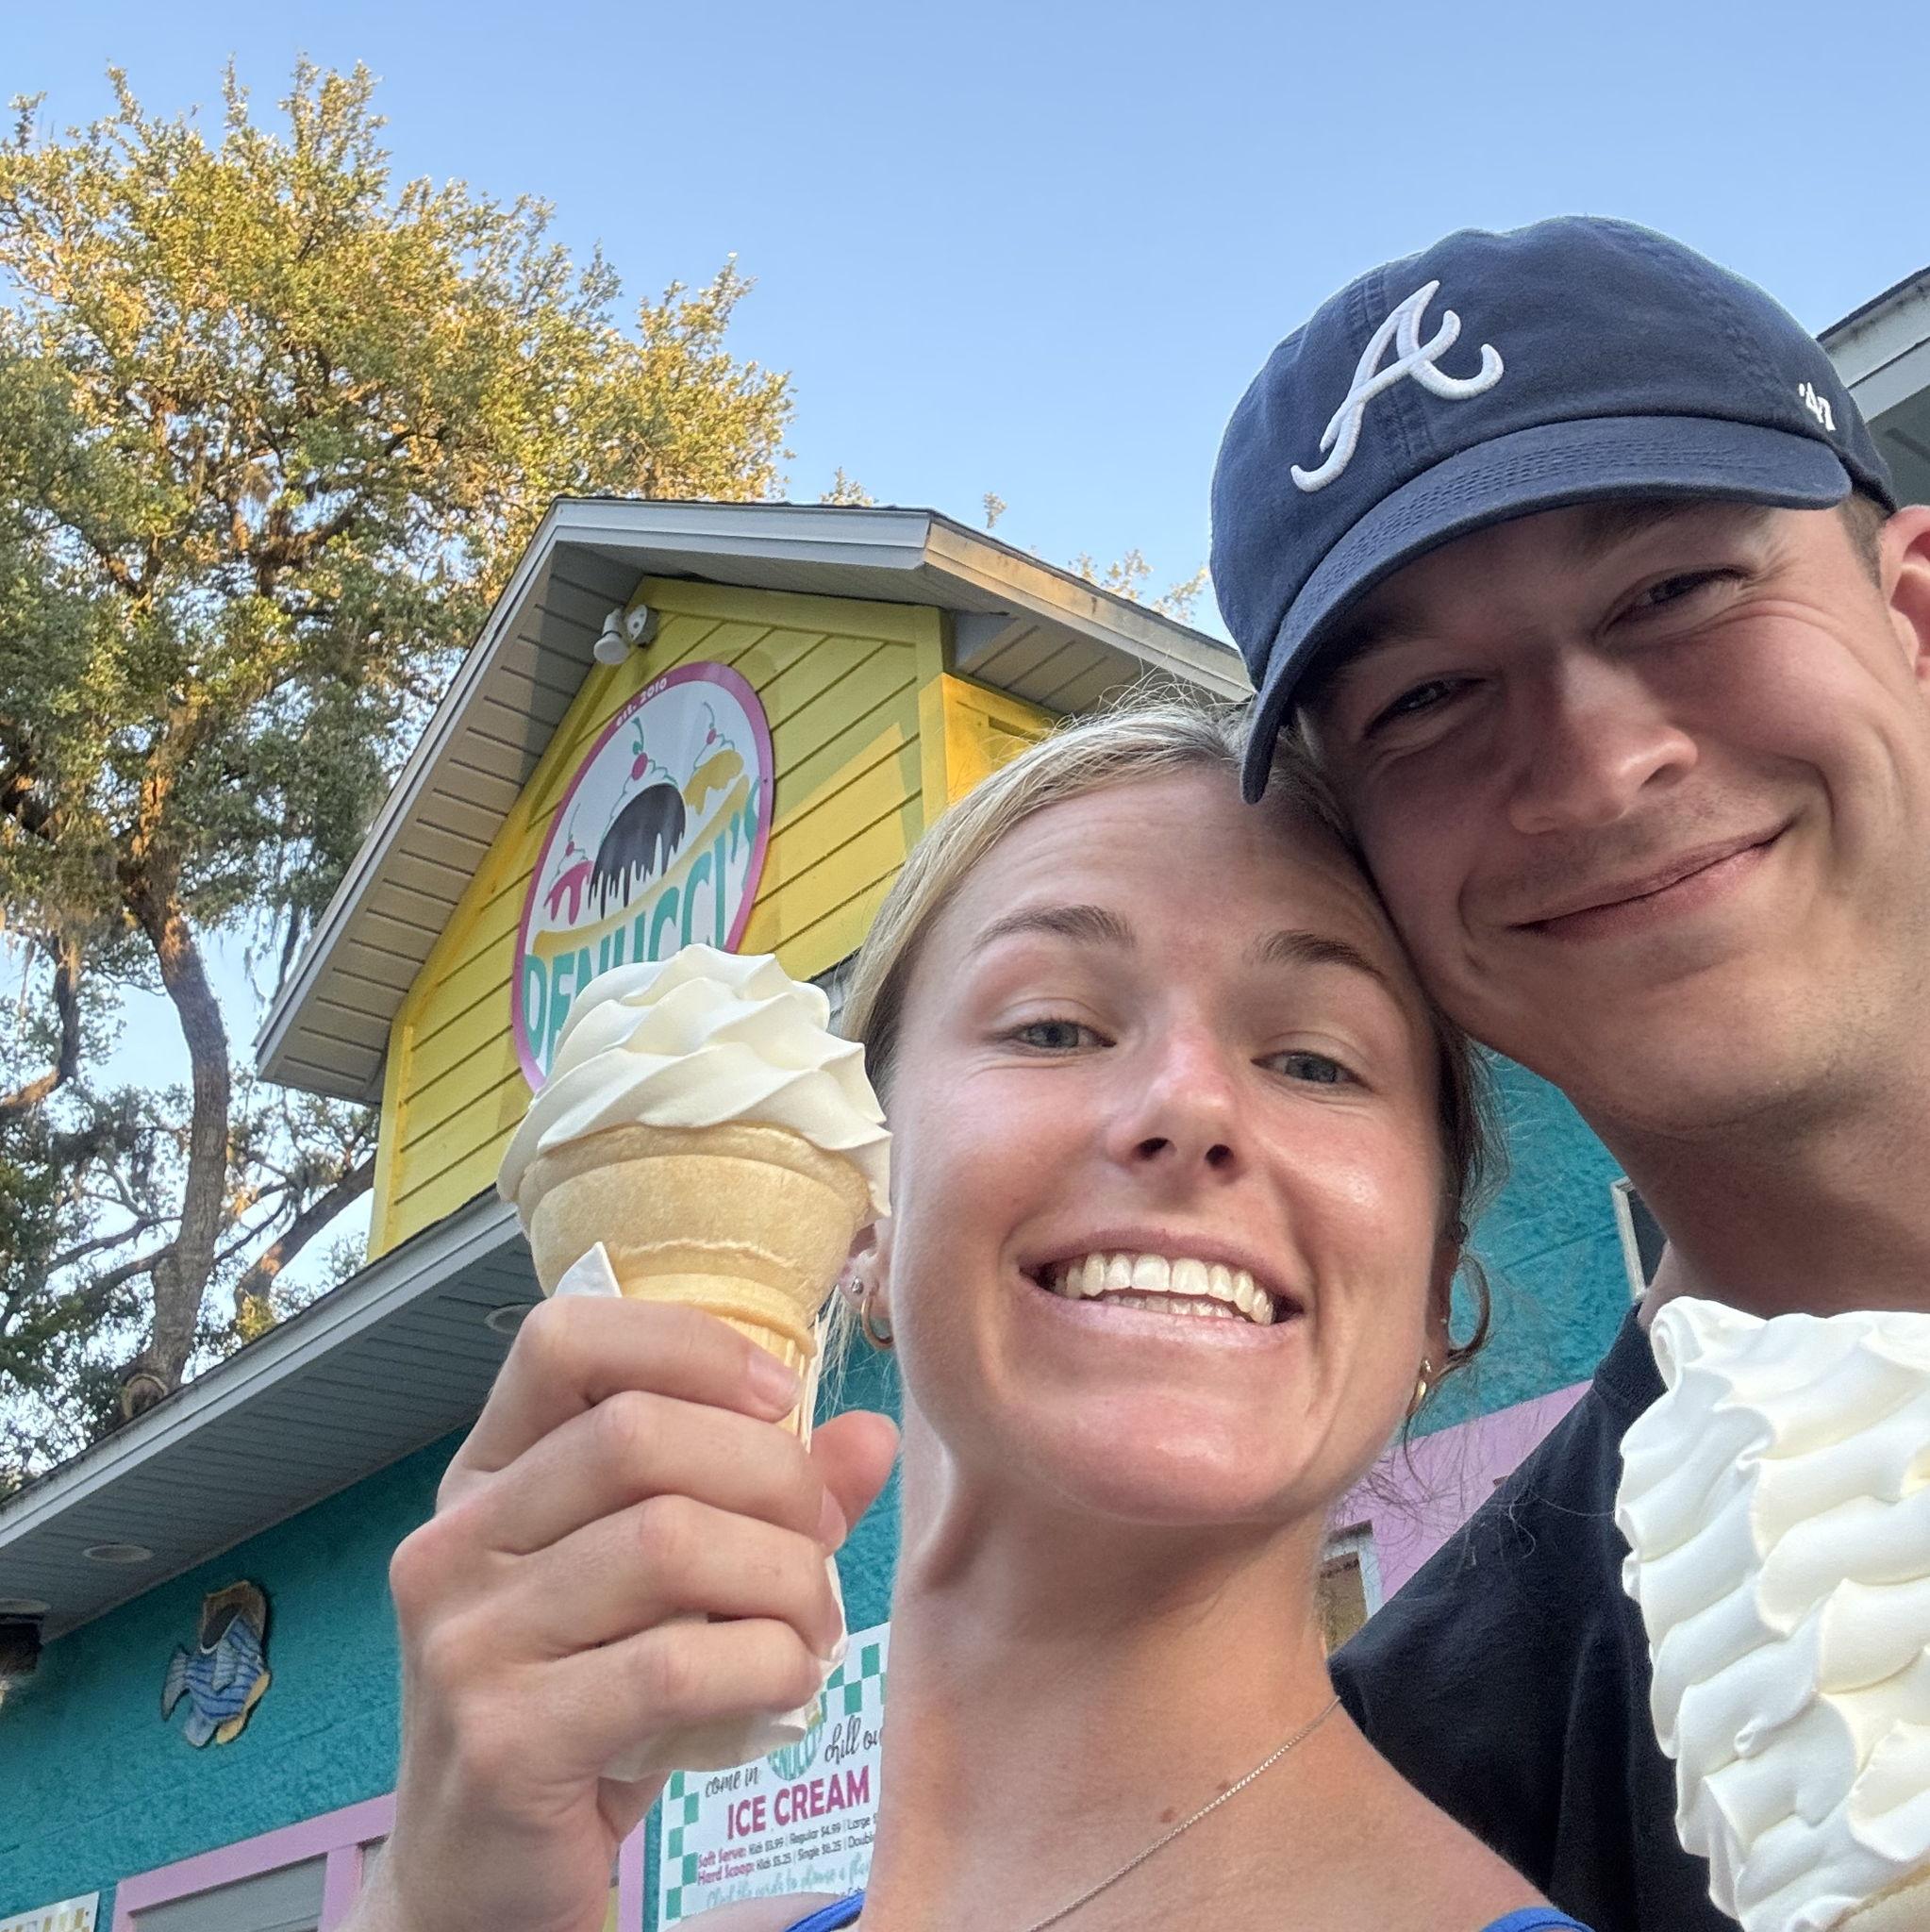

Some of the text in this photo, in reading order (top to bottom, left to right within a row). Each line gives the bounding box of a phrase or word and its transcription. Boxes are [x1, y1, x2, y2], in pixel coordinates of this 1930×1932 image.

[1290, 279, 1504, 492] A
[616, 677, 668, 727] est. 2010
[705, 1771, 741, 1798] come
[744, 1766, 759, 1788] in
[824, 1714, 862, 1765] chill
[726, 1765, 871, 1840] ICE CREAM
[847, 1817, 871, 1830] Large
